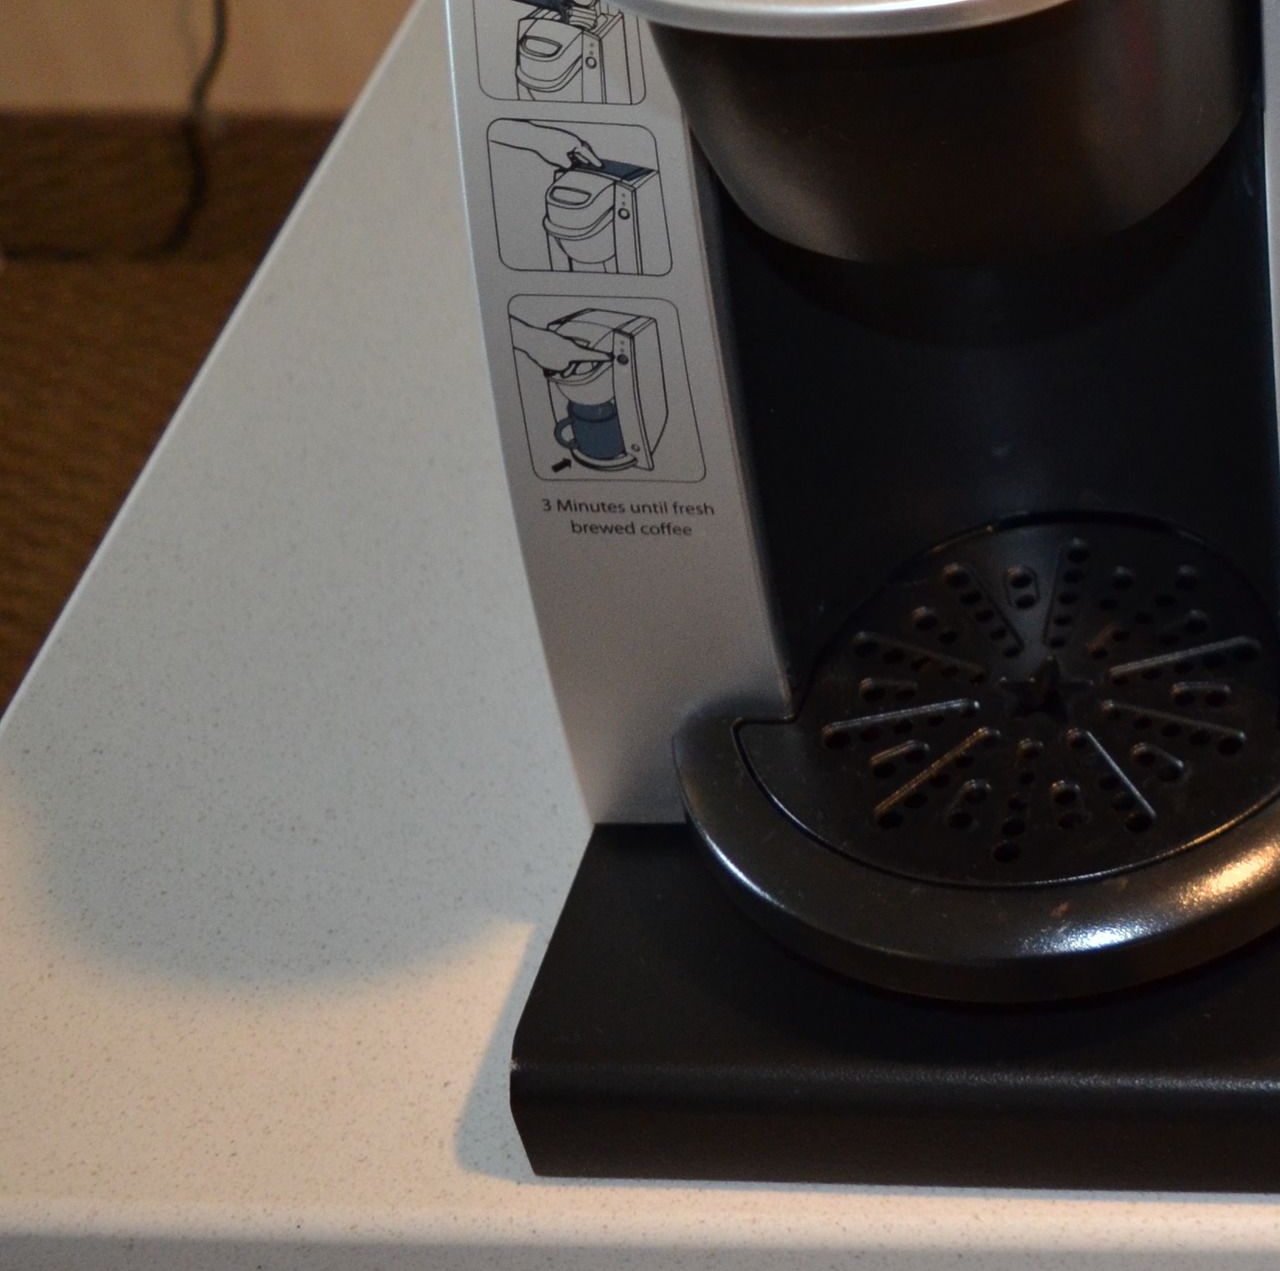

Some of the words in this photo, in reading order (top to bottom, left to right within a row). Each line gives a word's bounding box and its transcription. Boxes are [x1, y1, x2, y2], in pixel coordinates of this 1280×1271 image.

[542, 498, 551, 512] 3
[557, 499, 626, 514] Minutes
[631, 501, 668, 515] until
[673, 501, 715, 516] fresh
[571, 520, 635, 535] brewed
[640, 521, 692, 537] coffee
